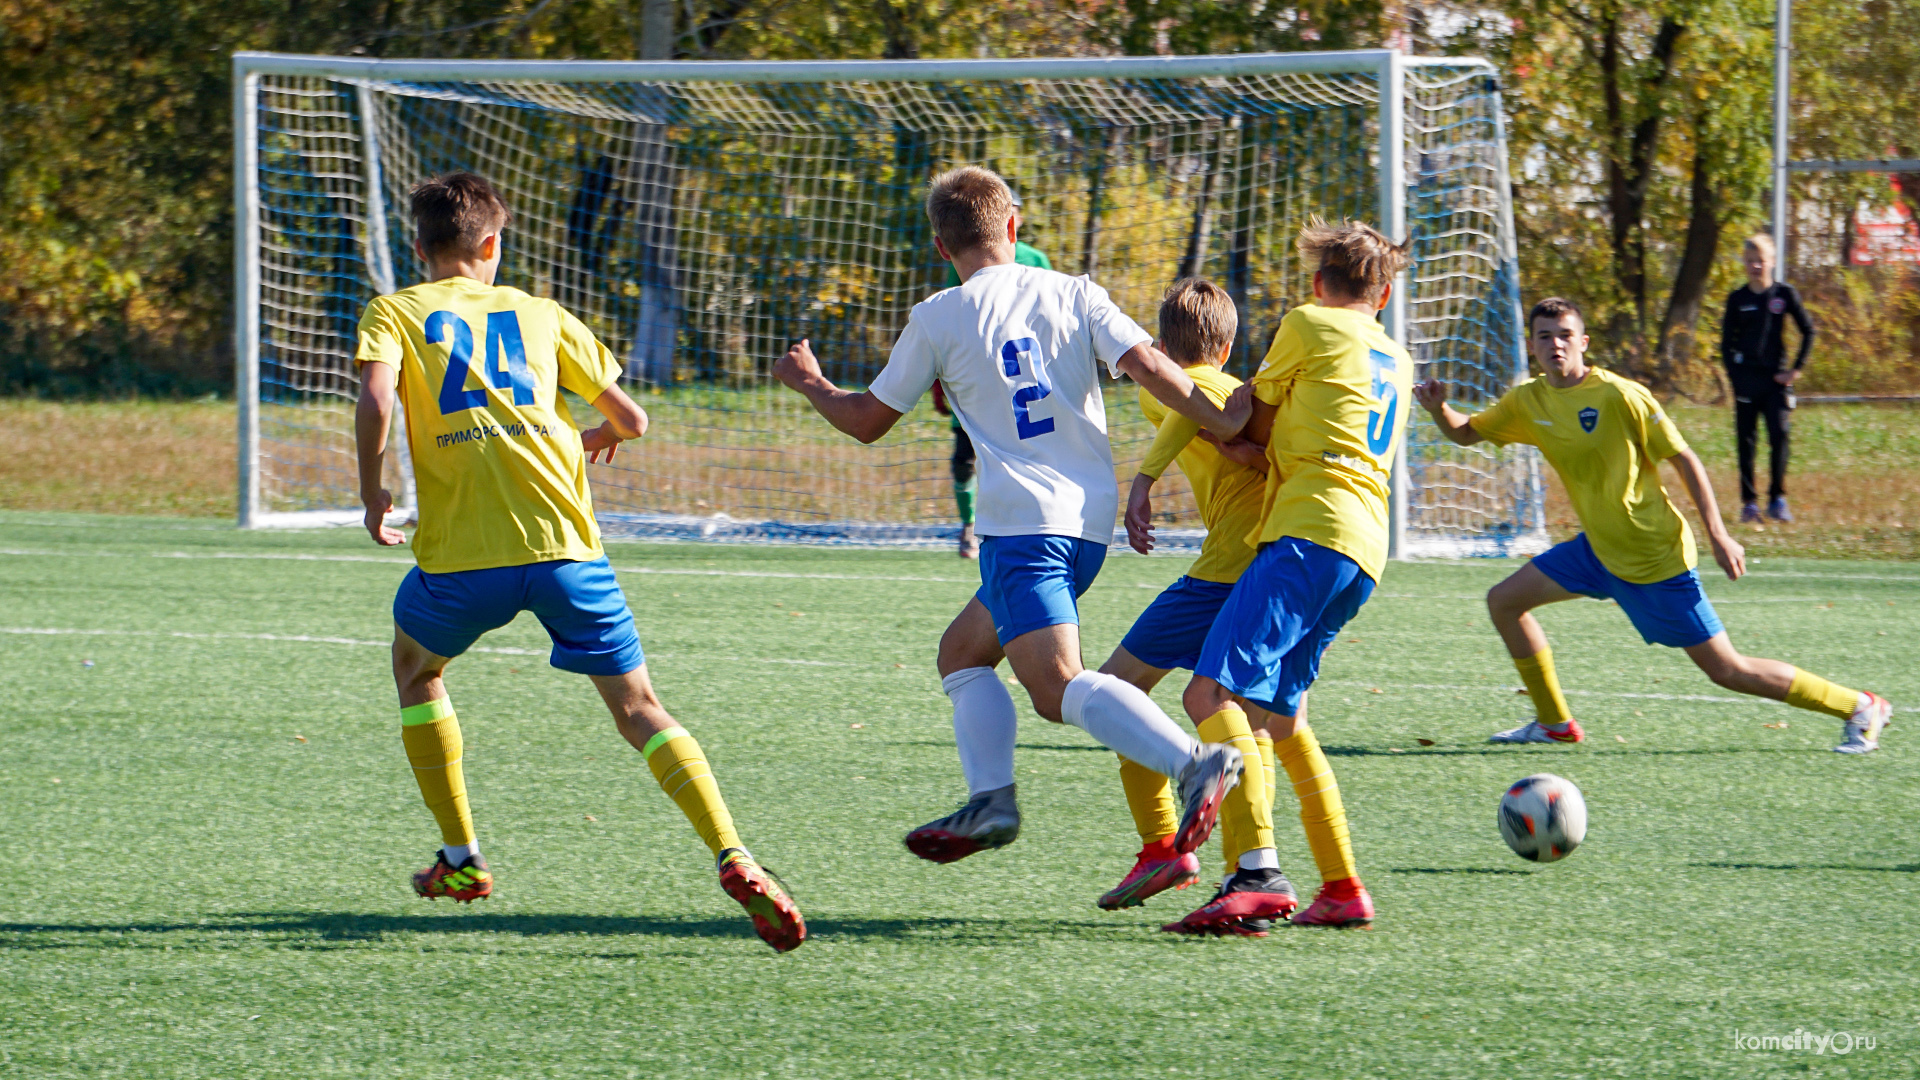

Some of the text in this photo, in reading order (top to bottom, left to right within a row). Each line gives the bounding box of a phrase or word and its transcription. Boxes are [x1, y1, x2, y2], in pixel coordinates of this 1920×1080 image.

[424, 310, 536, 416] 24
[1002, 337, 1055, 440] 2
[1367, 349, 1398, 456] 5
[436, 421, 526, 448] ПРИМОРСИЙ
